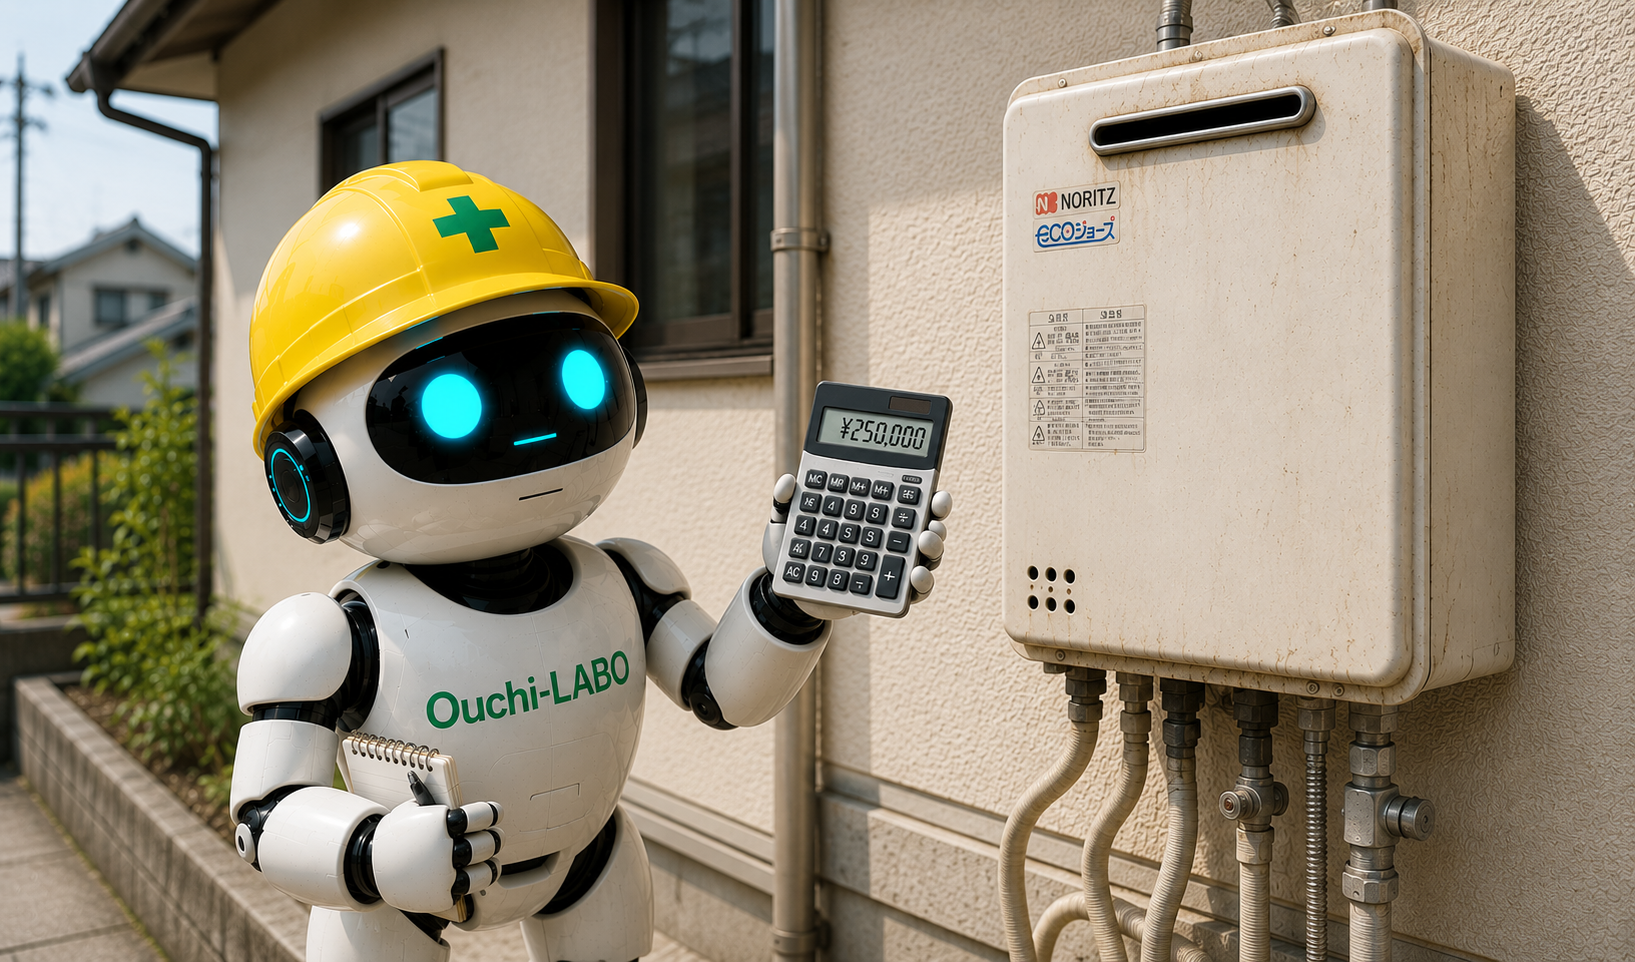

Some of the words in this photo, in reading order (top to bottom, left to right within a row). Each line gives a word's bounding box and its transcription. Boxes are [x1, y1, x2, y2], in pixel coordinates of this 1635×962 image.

[1061, 187, 1117, 210] NORITZ
[840, 417, 927, 450] ¥250,000
[807, 473, 823, 484] MC
[822, 523, 830, 535] 4
[818, 546, 826, 558] 7
[860, 554, 869, 566] 9
[786, 565, 801, 578] AC
[810, 569, 819, 582] 9
[832, 573, 842, 585] 8
[426, 650, 630, 729] Ouchi-LABO
